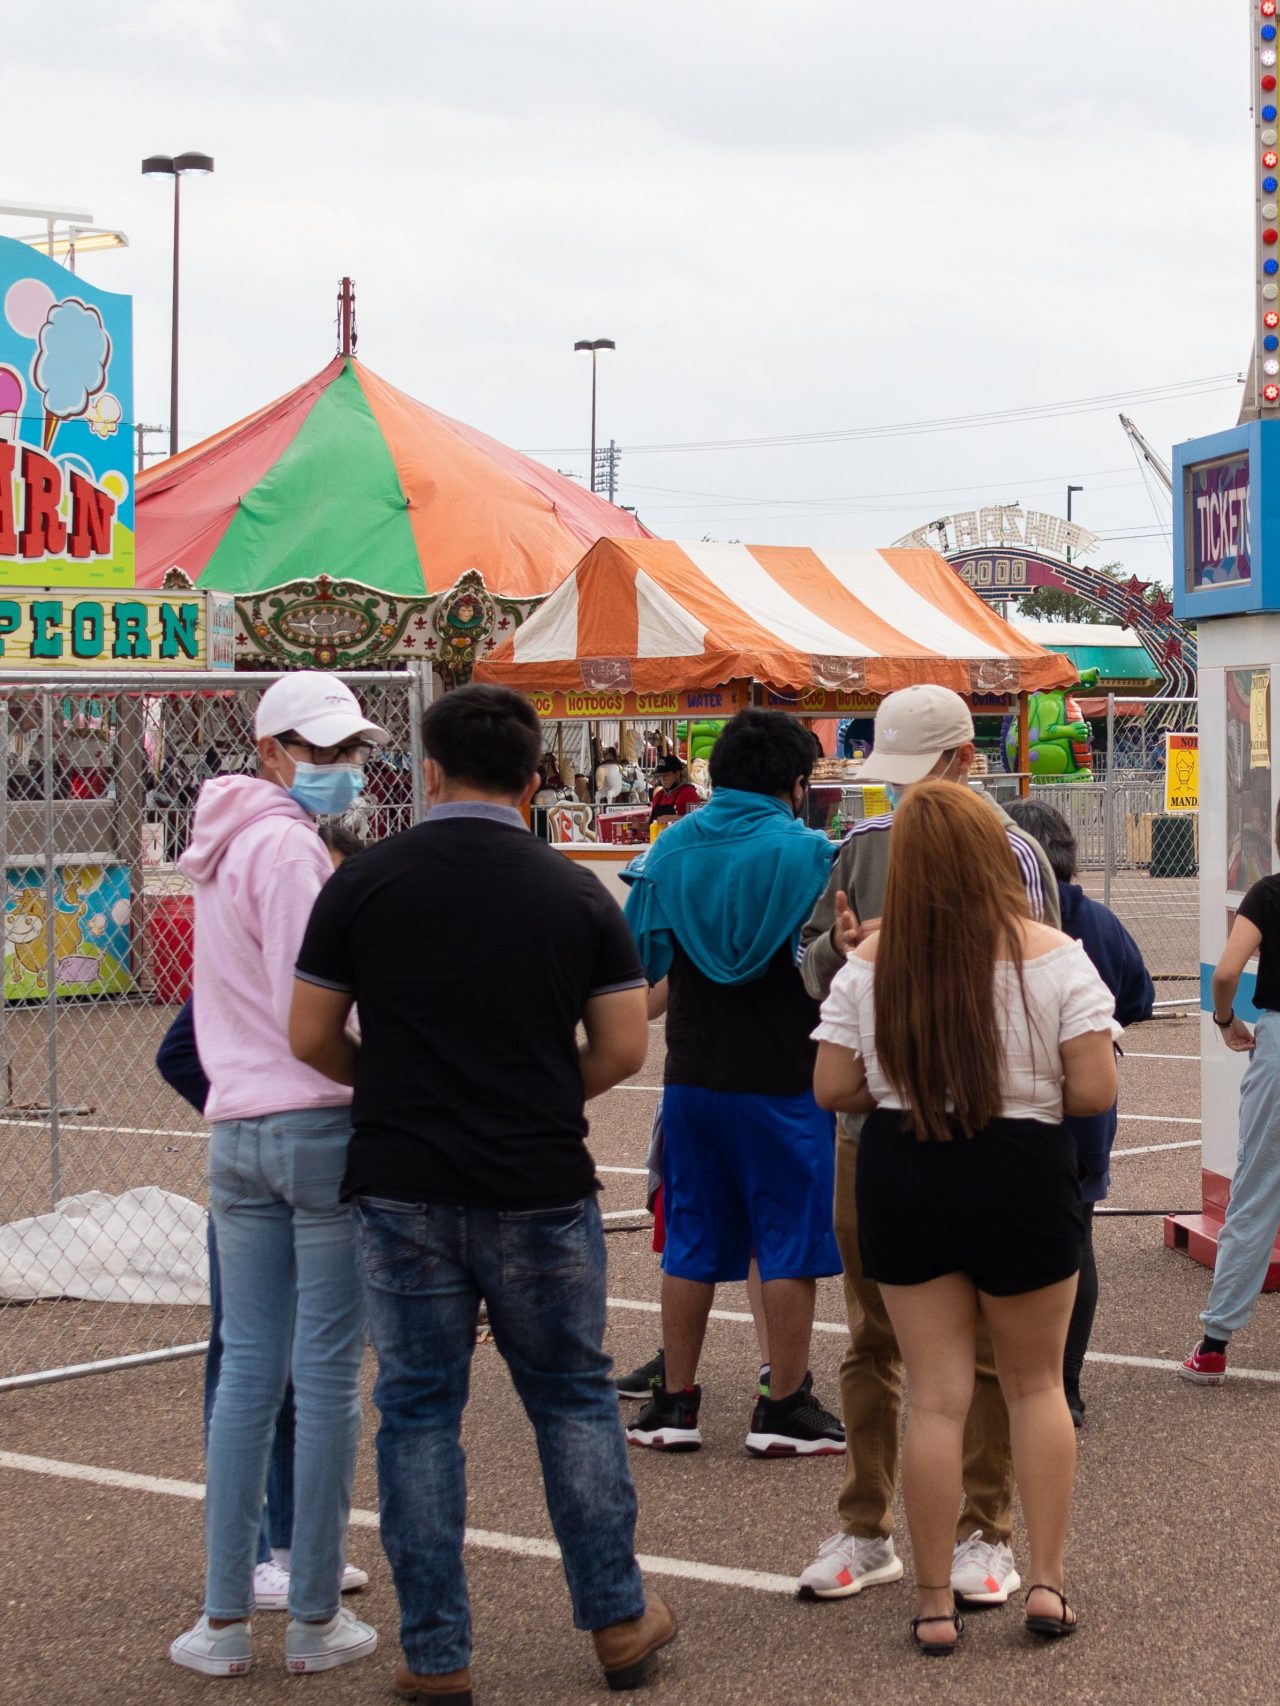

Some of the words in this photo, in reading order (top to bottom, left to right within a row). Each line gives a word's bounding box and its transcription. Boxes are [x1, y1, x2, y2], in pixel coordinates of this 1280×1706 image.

[958, 559, 1026, 586] 4000
[568, 695, 623, 711] HOTDOGS
[638, 692, 677, 709] STEAK
[687, 693, 723, 709] WATER
[1180, 737, 1199, 748] NOT
[1170, 797, 1199, 807] MAND
